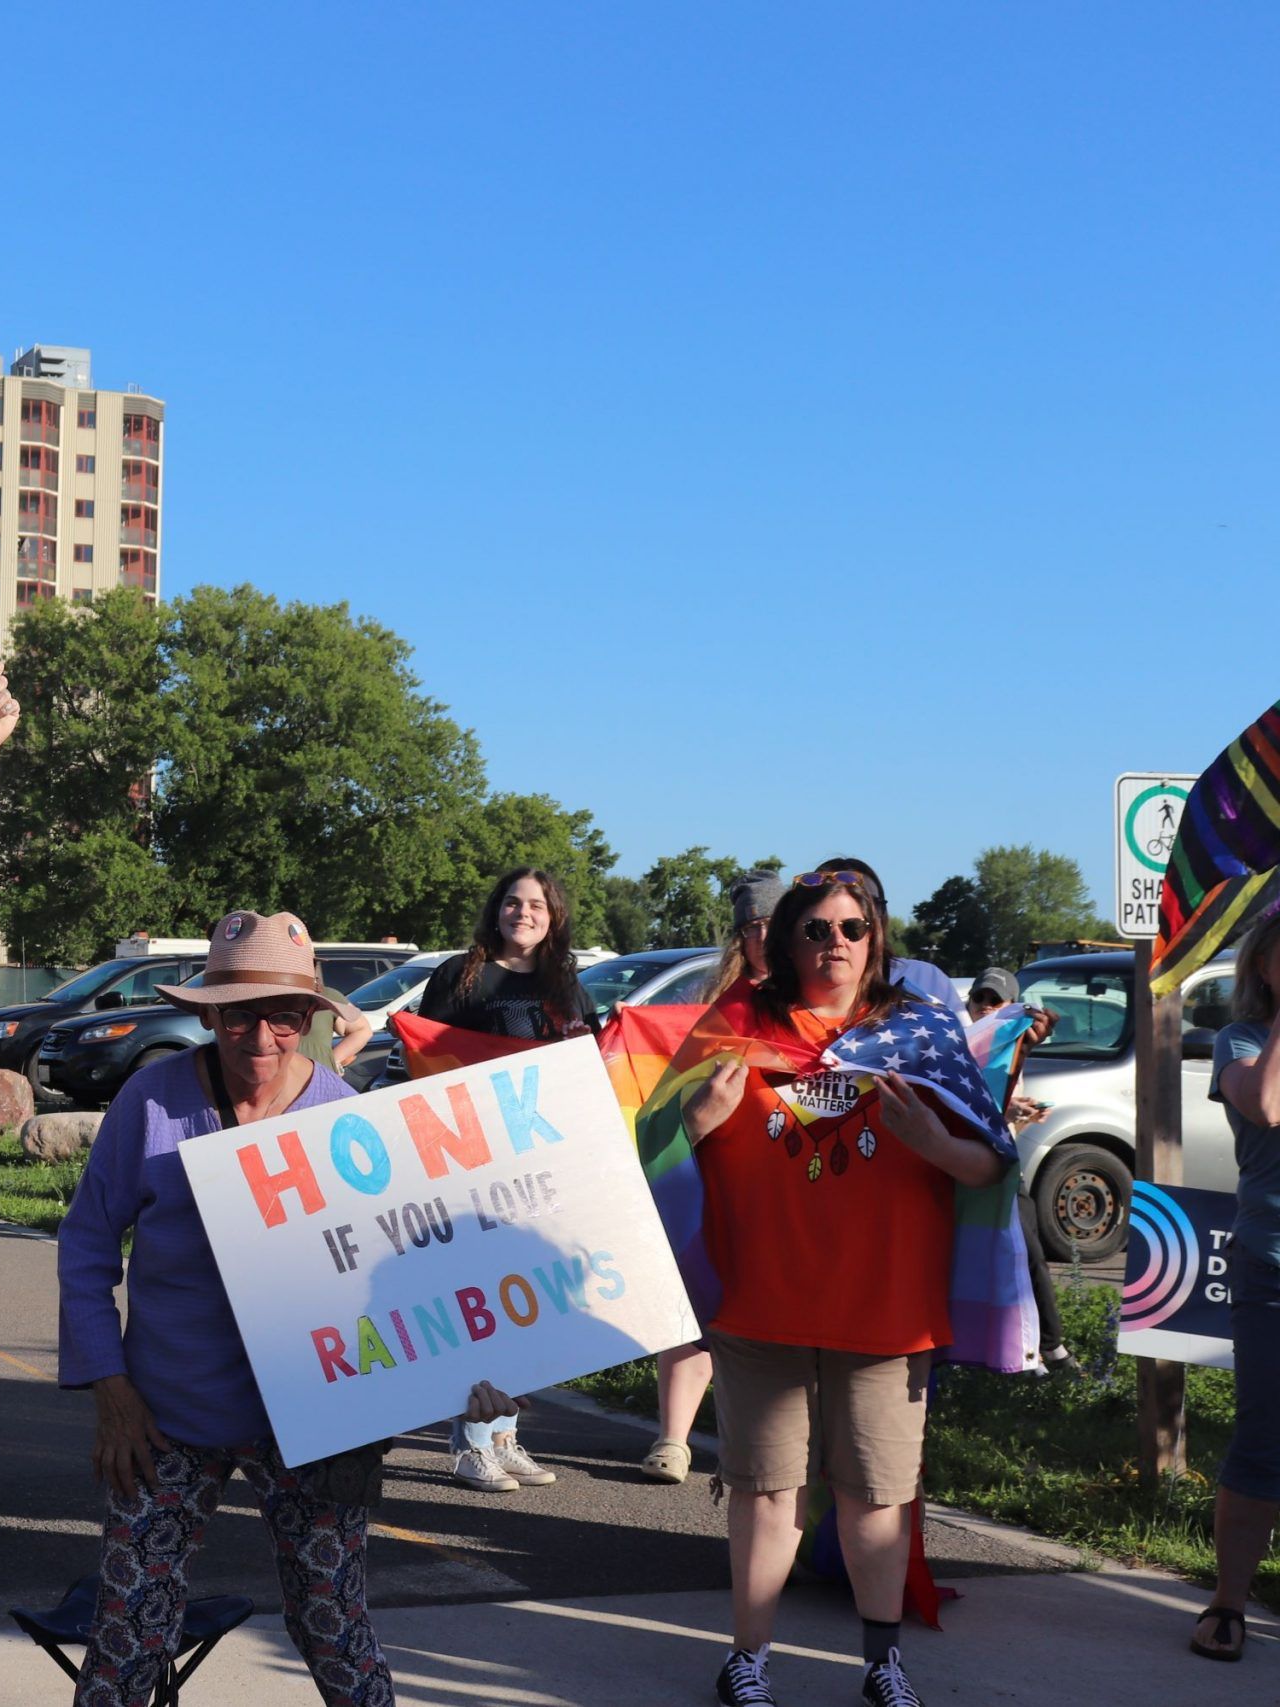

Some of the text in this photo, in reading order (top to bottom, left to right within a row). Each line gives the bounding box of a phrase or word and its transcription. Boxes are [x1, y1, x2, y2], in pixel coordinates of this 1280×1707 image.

[1131, 878, 1163, 900] SHA
[1124, 903, 1160, 925] PAT
[791, 1079, 859, 1101] CHILD
[797, 1095, 853, 1113] MATTERS
[235, 1064, 564, 1229] HONK
[322, 1170, 565, 1274] IF YOU LOVE
[310, 1249, 626, 1384] RAINBOWS
